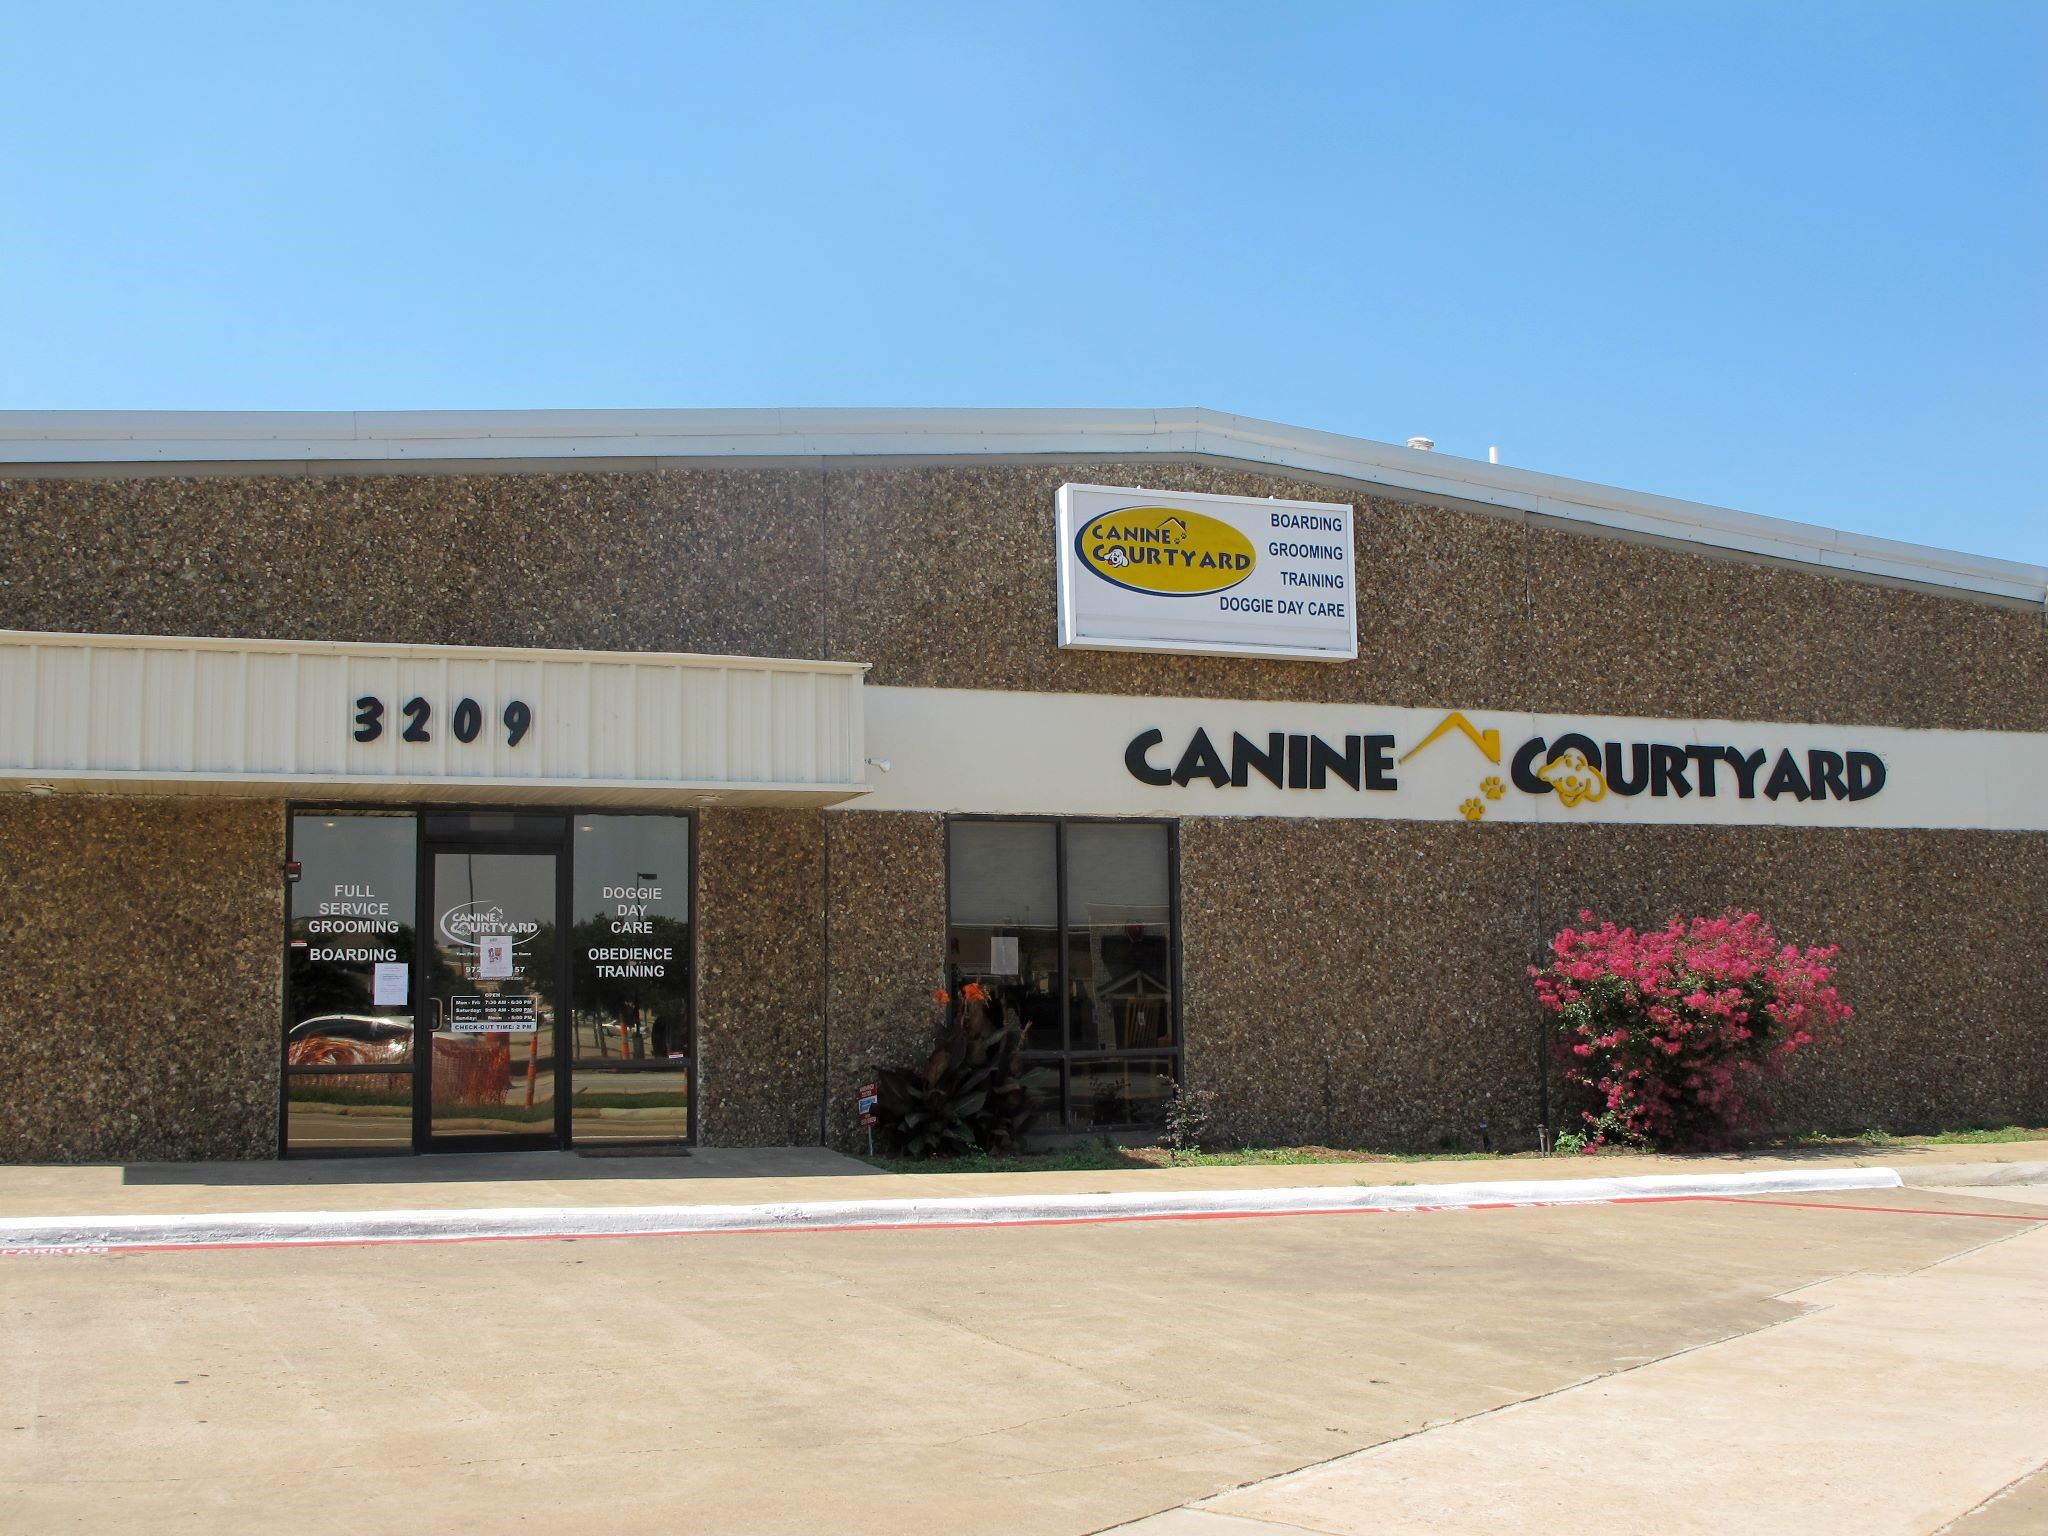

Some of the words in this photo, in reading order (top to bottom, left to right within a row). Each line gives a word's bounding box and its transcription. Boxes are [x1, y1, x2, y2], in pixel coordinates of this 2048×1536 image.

[1270, 513, 1342, 532] BOARDING
[1091, 524, 1171, 545] CANINE
[1268, 542, 1343, 561] GROOMING
[1280, 571, 1344, 589] TRAINING
[1219, 596, 1274, 613] DOGGIE
[1277, 600, 1304, 615] DAY
[1308, 602, 1345, 618] CARE
[354, 696, 532, 747] 3209
[1124, 727, 1398, 791] CANINE
[1510, 732, 1886, 803] COURTYARD
[334, 884, 375, 897] FULL
[603, 886, 662, 900] DOGGIE
[319, 902, 389, 915] SERVICE
[617, 904, 648, 916] DAY
[452, 912, 497, 922] CANINE
[308, 920, 399, 933] GROOMING
[610, 921, 653, 934] CARE
[310, 948, 397, 961] BOARDING
[588, 947, 673, 960] OBEDIENCE
[596, 965, 665, 978] TRAINING
